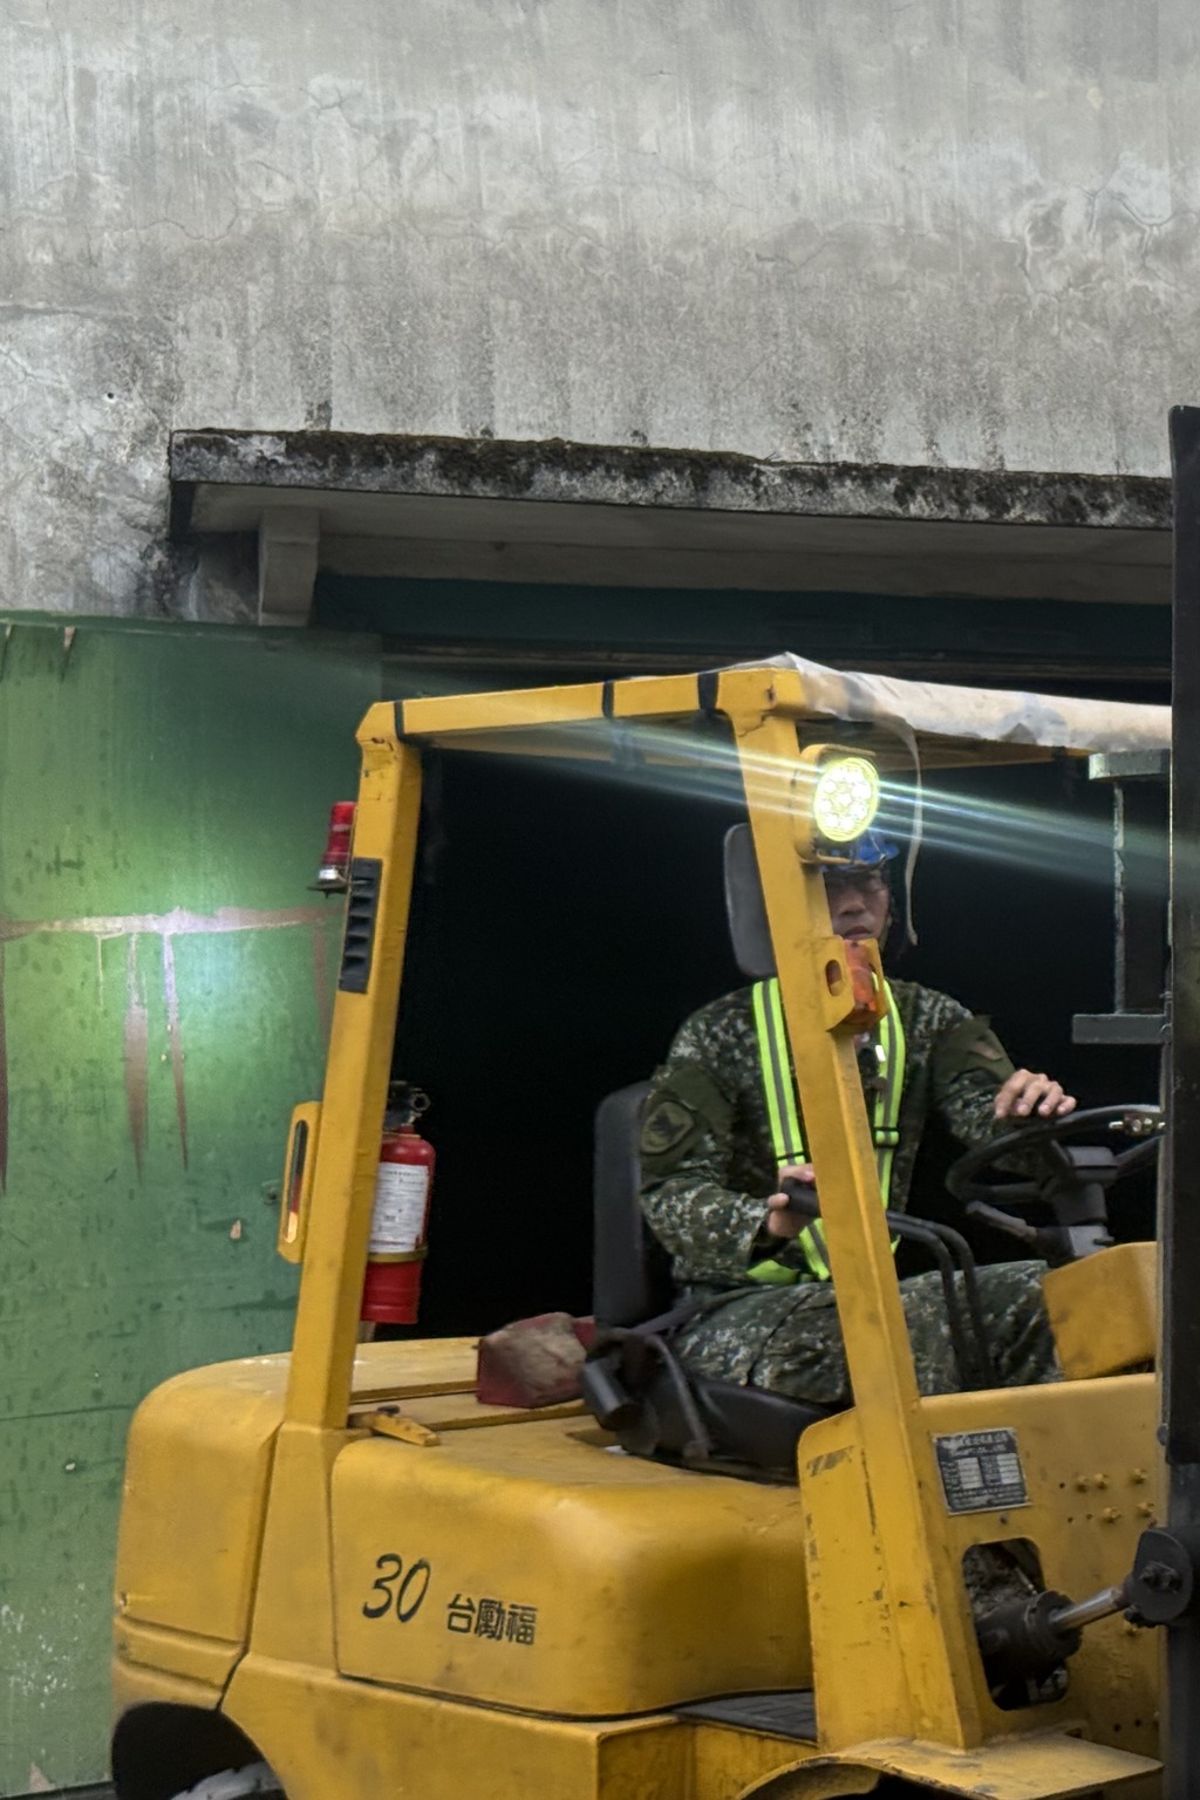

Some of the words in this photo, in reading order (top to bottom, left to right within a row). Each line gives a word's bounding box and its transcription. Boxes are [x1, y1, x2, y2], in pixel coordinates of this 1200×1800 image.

[362, 1553, 431, 1623] 30
[446, 1593, 539, 1646] 台勵福
